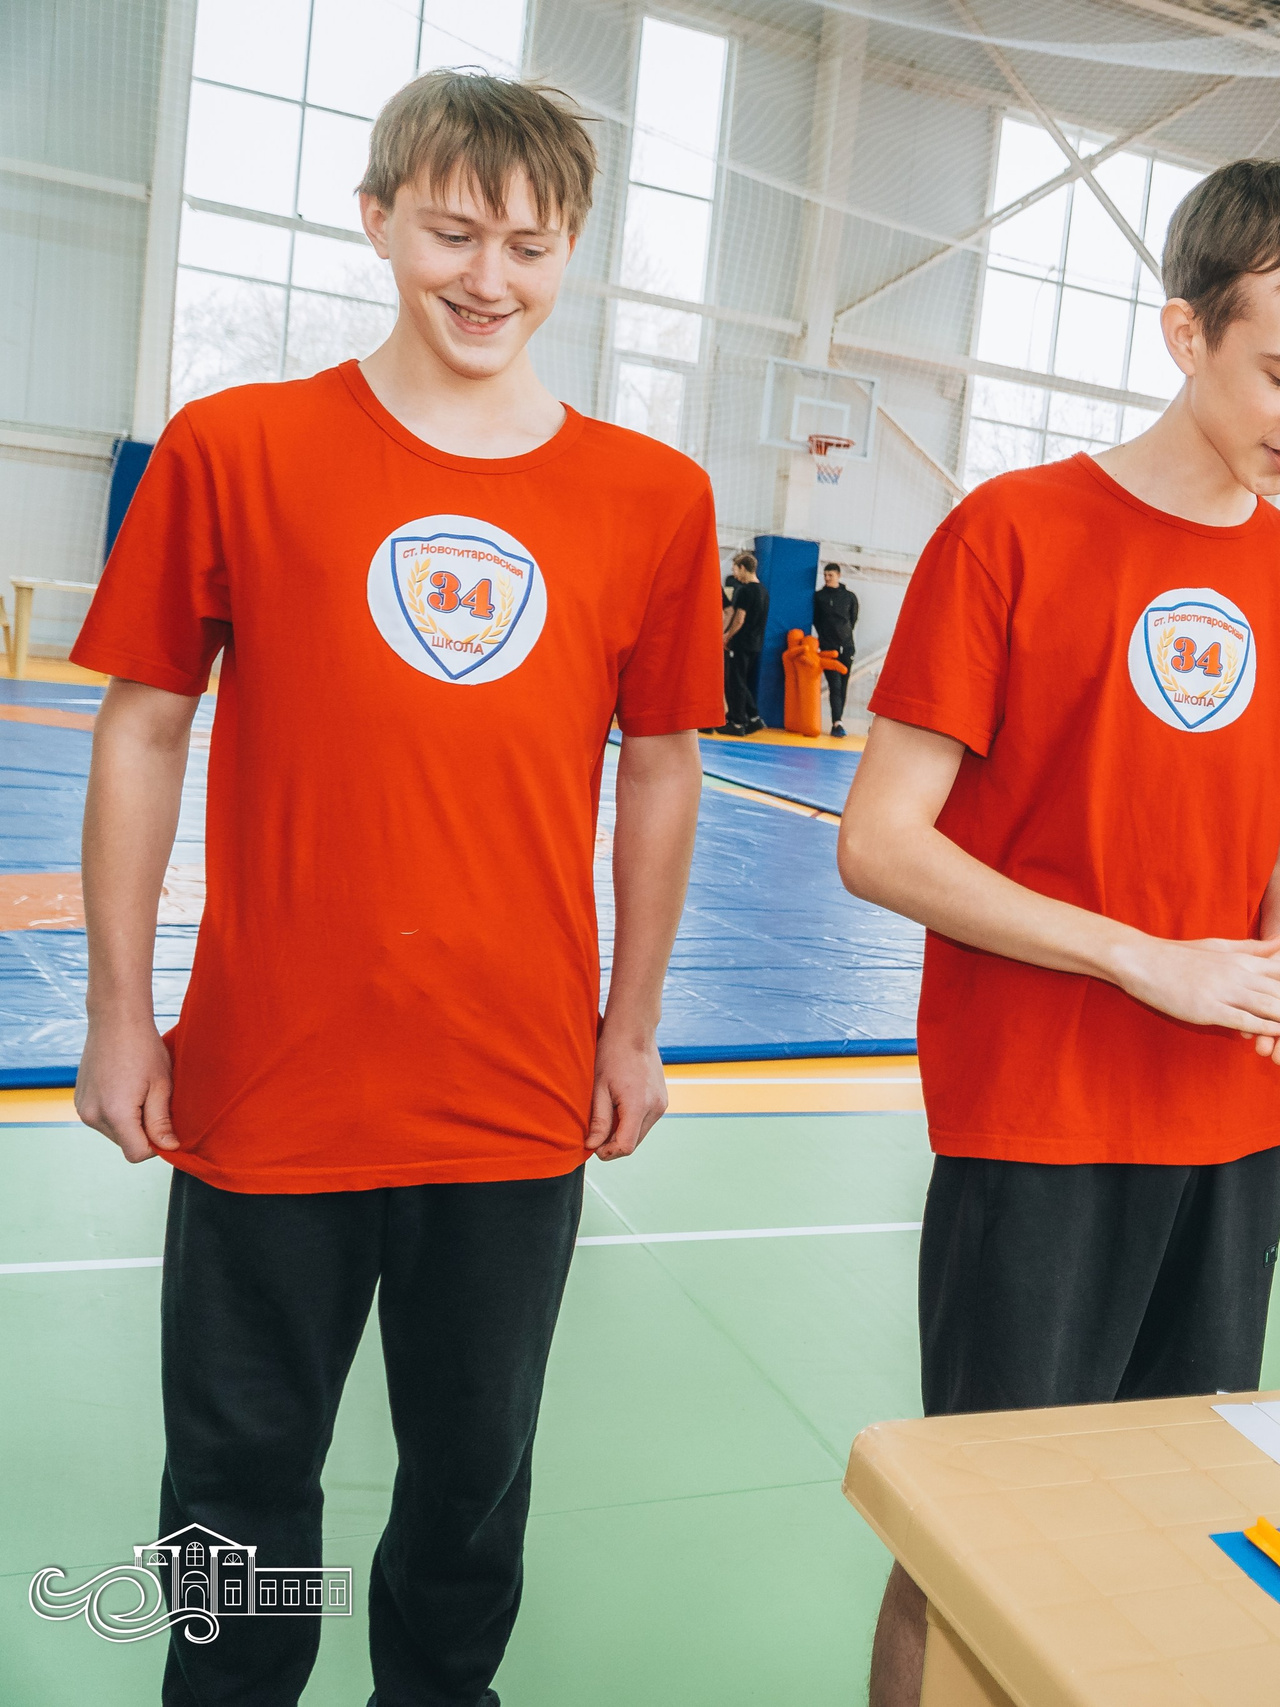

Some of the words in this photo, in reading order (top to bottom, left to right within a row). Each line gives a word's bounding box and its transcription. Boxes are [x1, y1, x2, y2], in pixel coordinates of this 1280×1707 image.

[402, 547, 418, 559] ст.
[420, 543, 524, 579] Новотитаровская
[427, 571, 495, 620] 34
[1153, 616, 1166, 627] ст.
[1167, 612, 1244, 642] Новотитаровская
[431, 635, 485, 655] ШКОЛА
[1171, 636, 1223, 677] 34
[1173, 692, 1215, 708] ШКОЛА
